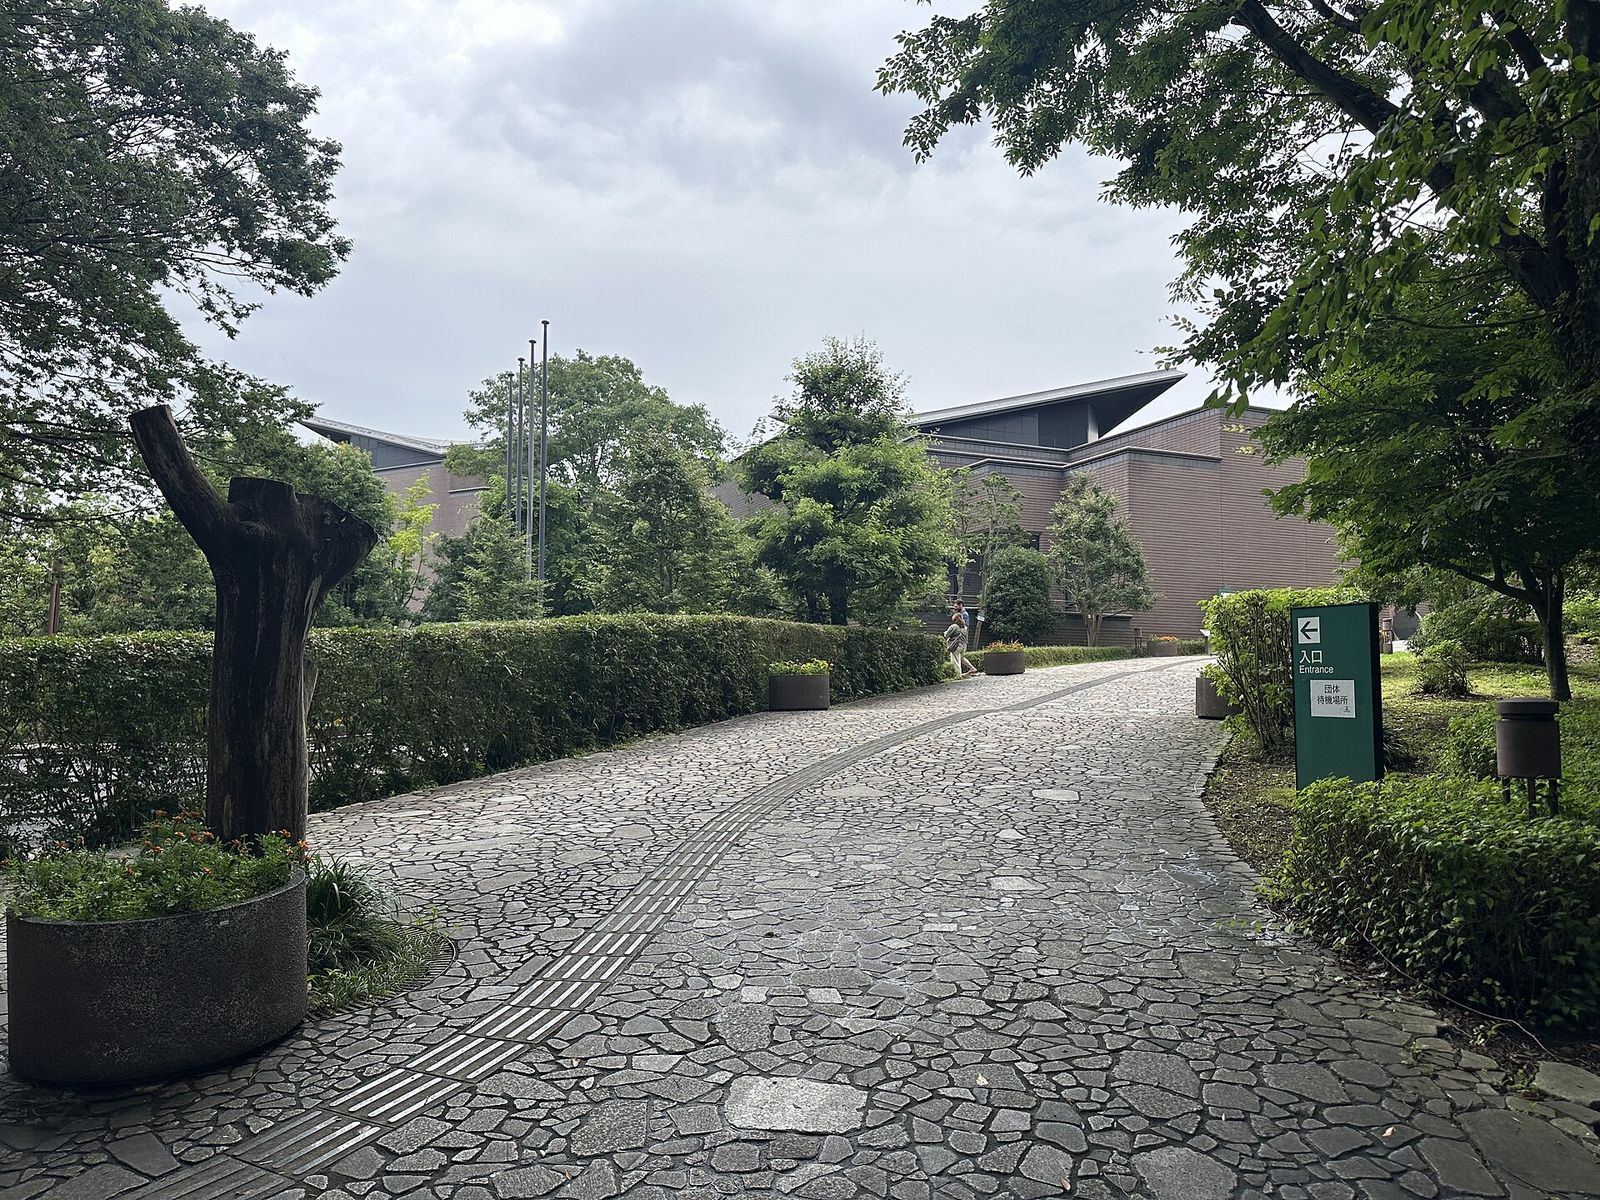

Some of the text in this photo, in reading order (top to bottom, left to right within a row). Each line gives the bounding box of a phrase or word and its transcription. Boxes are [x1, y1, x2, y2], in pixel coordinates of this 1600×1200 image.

[1299, 650, 1323, 664] 入口
[1299, 664, 1334, 674] Entrance
[1324, 684, 1341, 694] 団体
[1316, 695, 1348, 705] 待機場所
